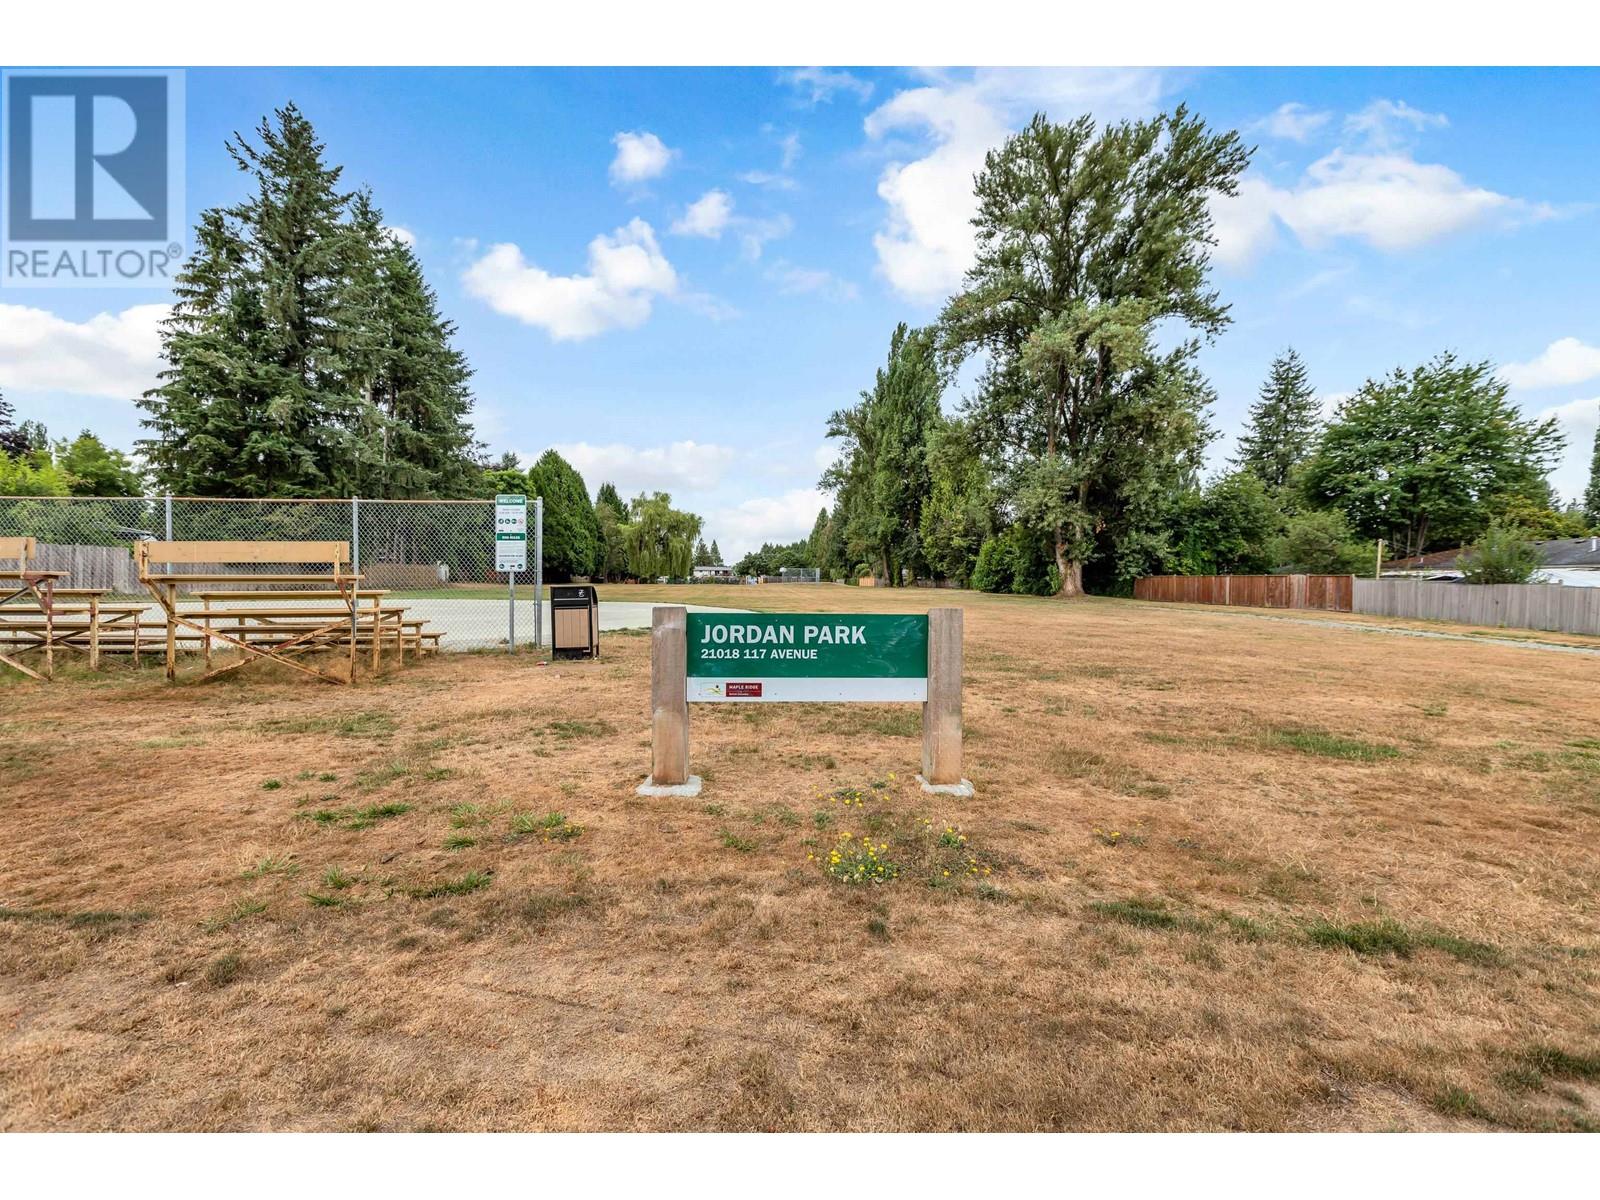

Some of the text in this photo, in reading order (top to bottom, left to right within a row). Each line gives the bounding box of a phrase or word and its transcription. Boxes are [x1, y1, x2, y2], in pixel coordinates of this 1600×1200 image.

[701, 625, 867, 644] JORDAN PARK
[701, 649, 818, 659] 21018 117 AVENUE
